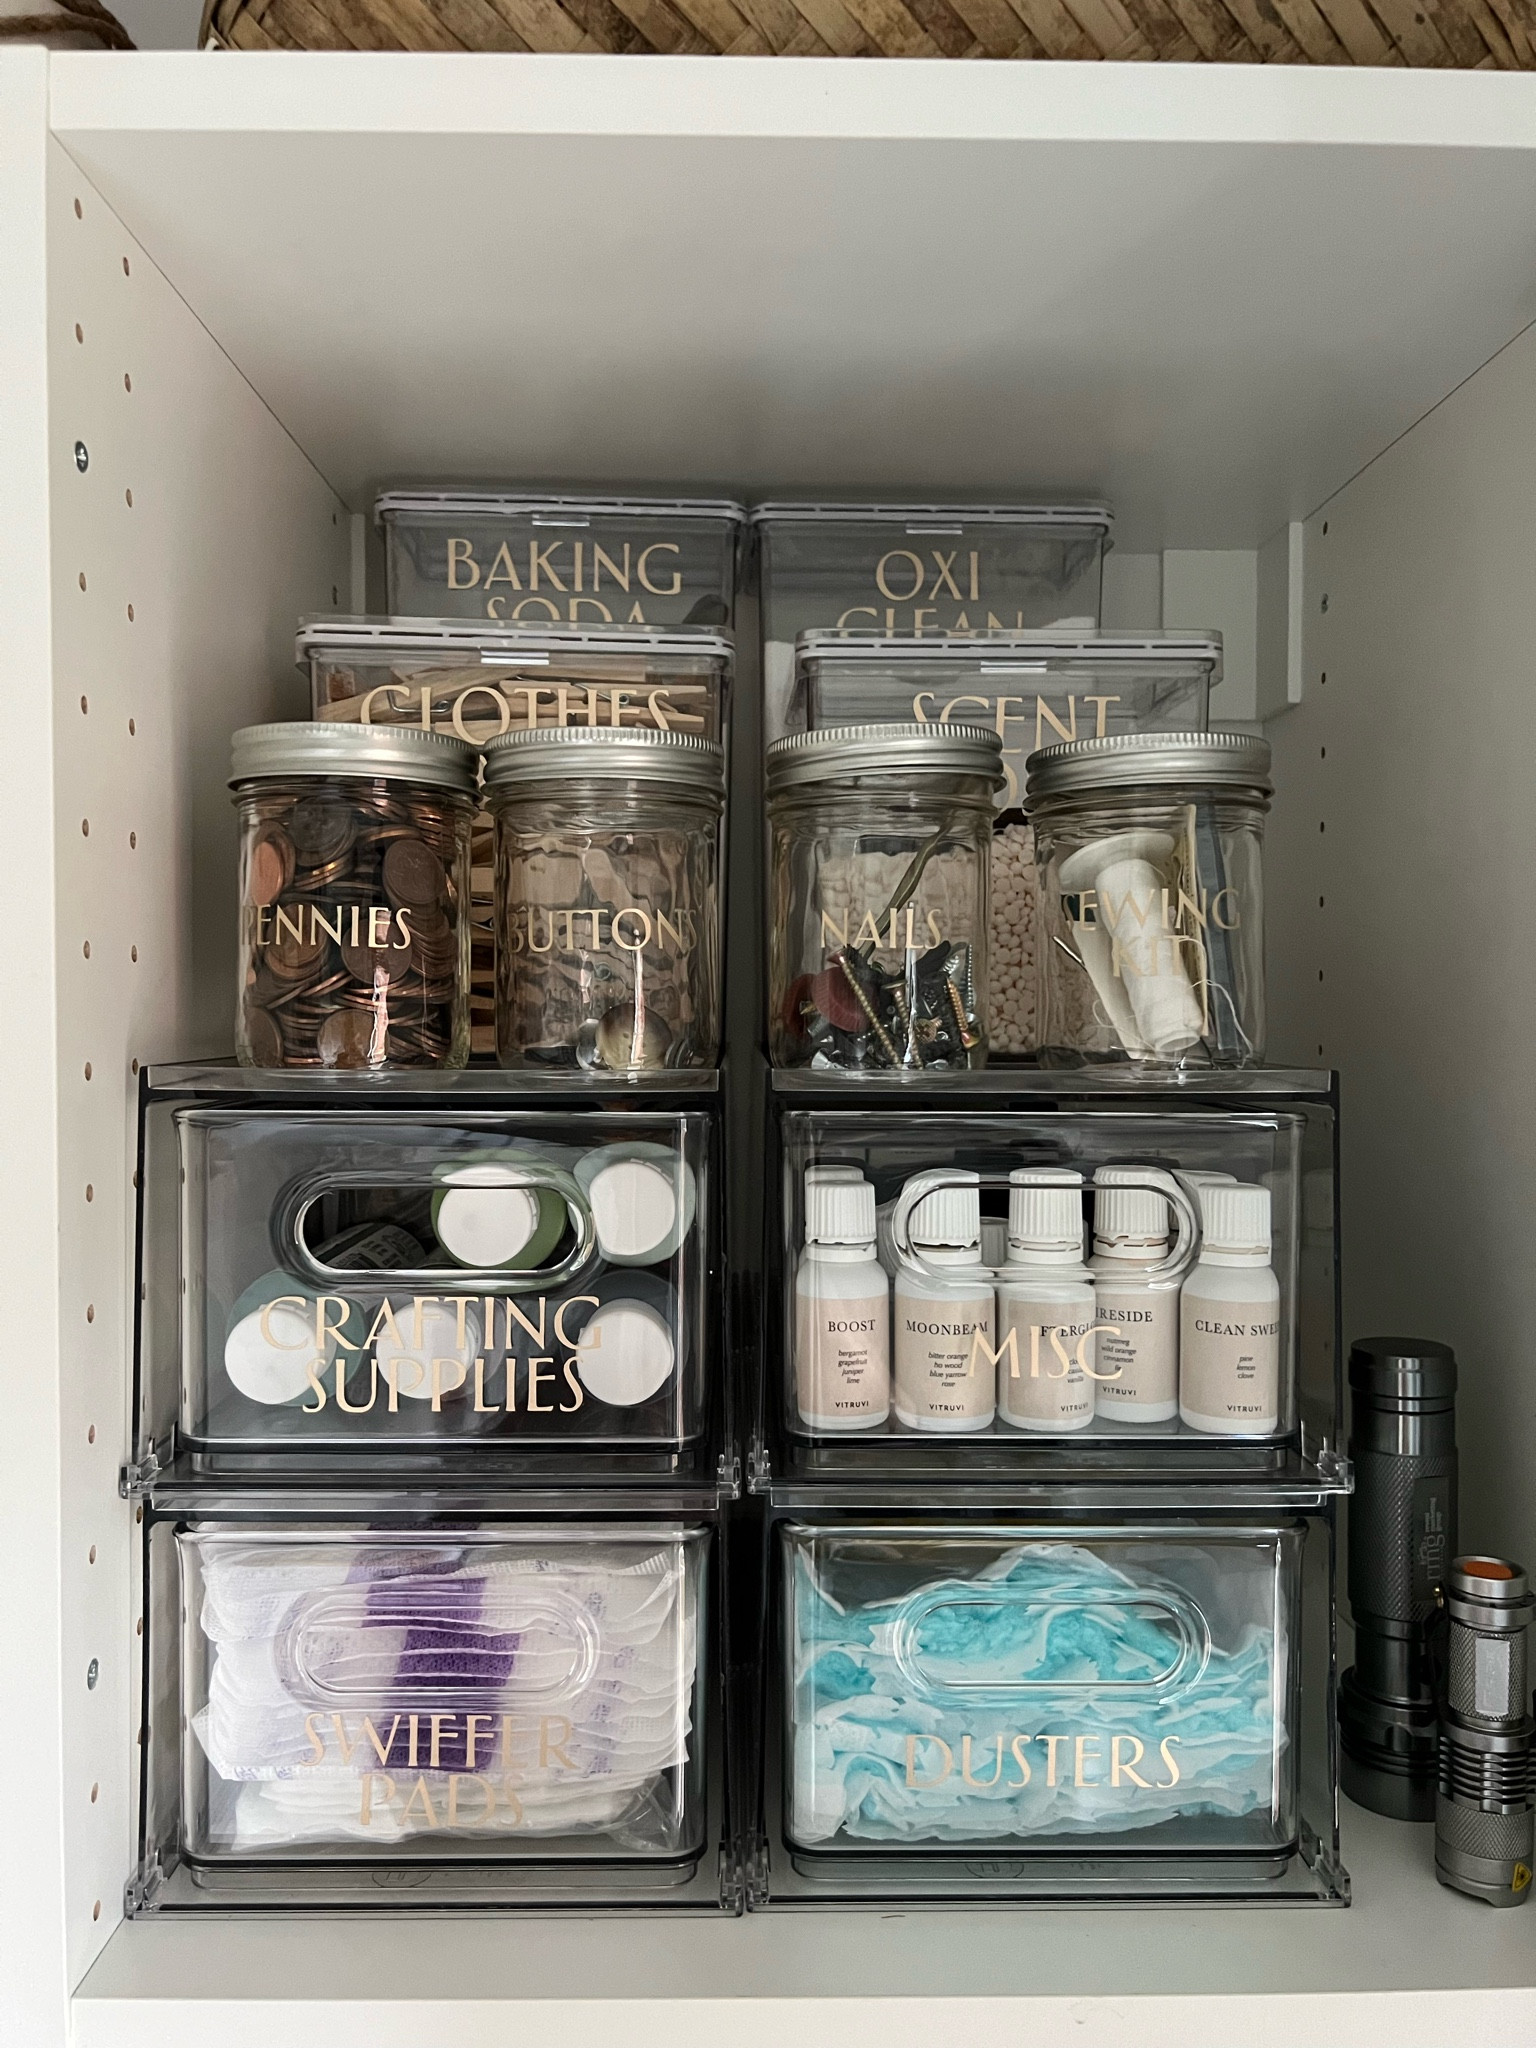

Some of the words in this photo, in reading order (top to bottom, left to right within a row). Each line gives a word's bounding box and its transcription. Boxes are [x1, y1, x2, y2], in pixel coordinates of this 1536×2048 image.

[447, 538, 682, 596] BAKING
[876, 550, 980, 601] OXI
[360, 685, 670, 745] CLOTHES
[820, 907, 943, 949] NAILS
[1112, 934, 1189, 977] KIT
[1095, 1306, 1153, 1322] IRESIDE
[260, 1296, 602, 1351] CRAFTING
[828, 1319, 876, 1332] BOOST
[906, 1320, 988, 1336] MOONBEAM
[1195, 1319, 1246, 1336] CLEAN
[837, 1350, 868, 1358] bergamot
[928, 1351, 945, 1360] bitter
[946, 1353, 969, 1362] orange
[968, 1325, 1122, 1380] MISC
[1114, 1348, 1137, 1356] orange
[837, 1358, 868, 1368] grapefruit
[944, 1361, 963, 1369] wood
[1236, 1363, 1256, 1371] lemon
[841, 1368, 864, 1377] juniper
[929, 1369, 944, 1378] blue
[944, 1371, 967, 1379] yarrow
[1237, 1371, 1255, 1379] clove
[302, 1356, 585, 1412] SUPPLIES
[846, 1376, 861, 1384] lime
[1103, 1386, 1137, 1396] VITRUVI
[835, 1401, 869, 1409] VITRUVI
[929, 1403, 965, 1411] VITRUVI
[1060, 1402, 1089, 1412] VITRUVI
[1226, 1404, 1262, 1412] VITRUVI
[299, 1712, 579, 1768] SWIFFER
[904, 1734, 1182, 1789] DUSTERS
[360, 1773, 524, 1827] PADS
